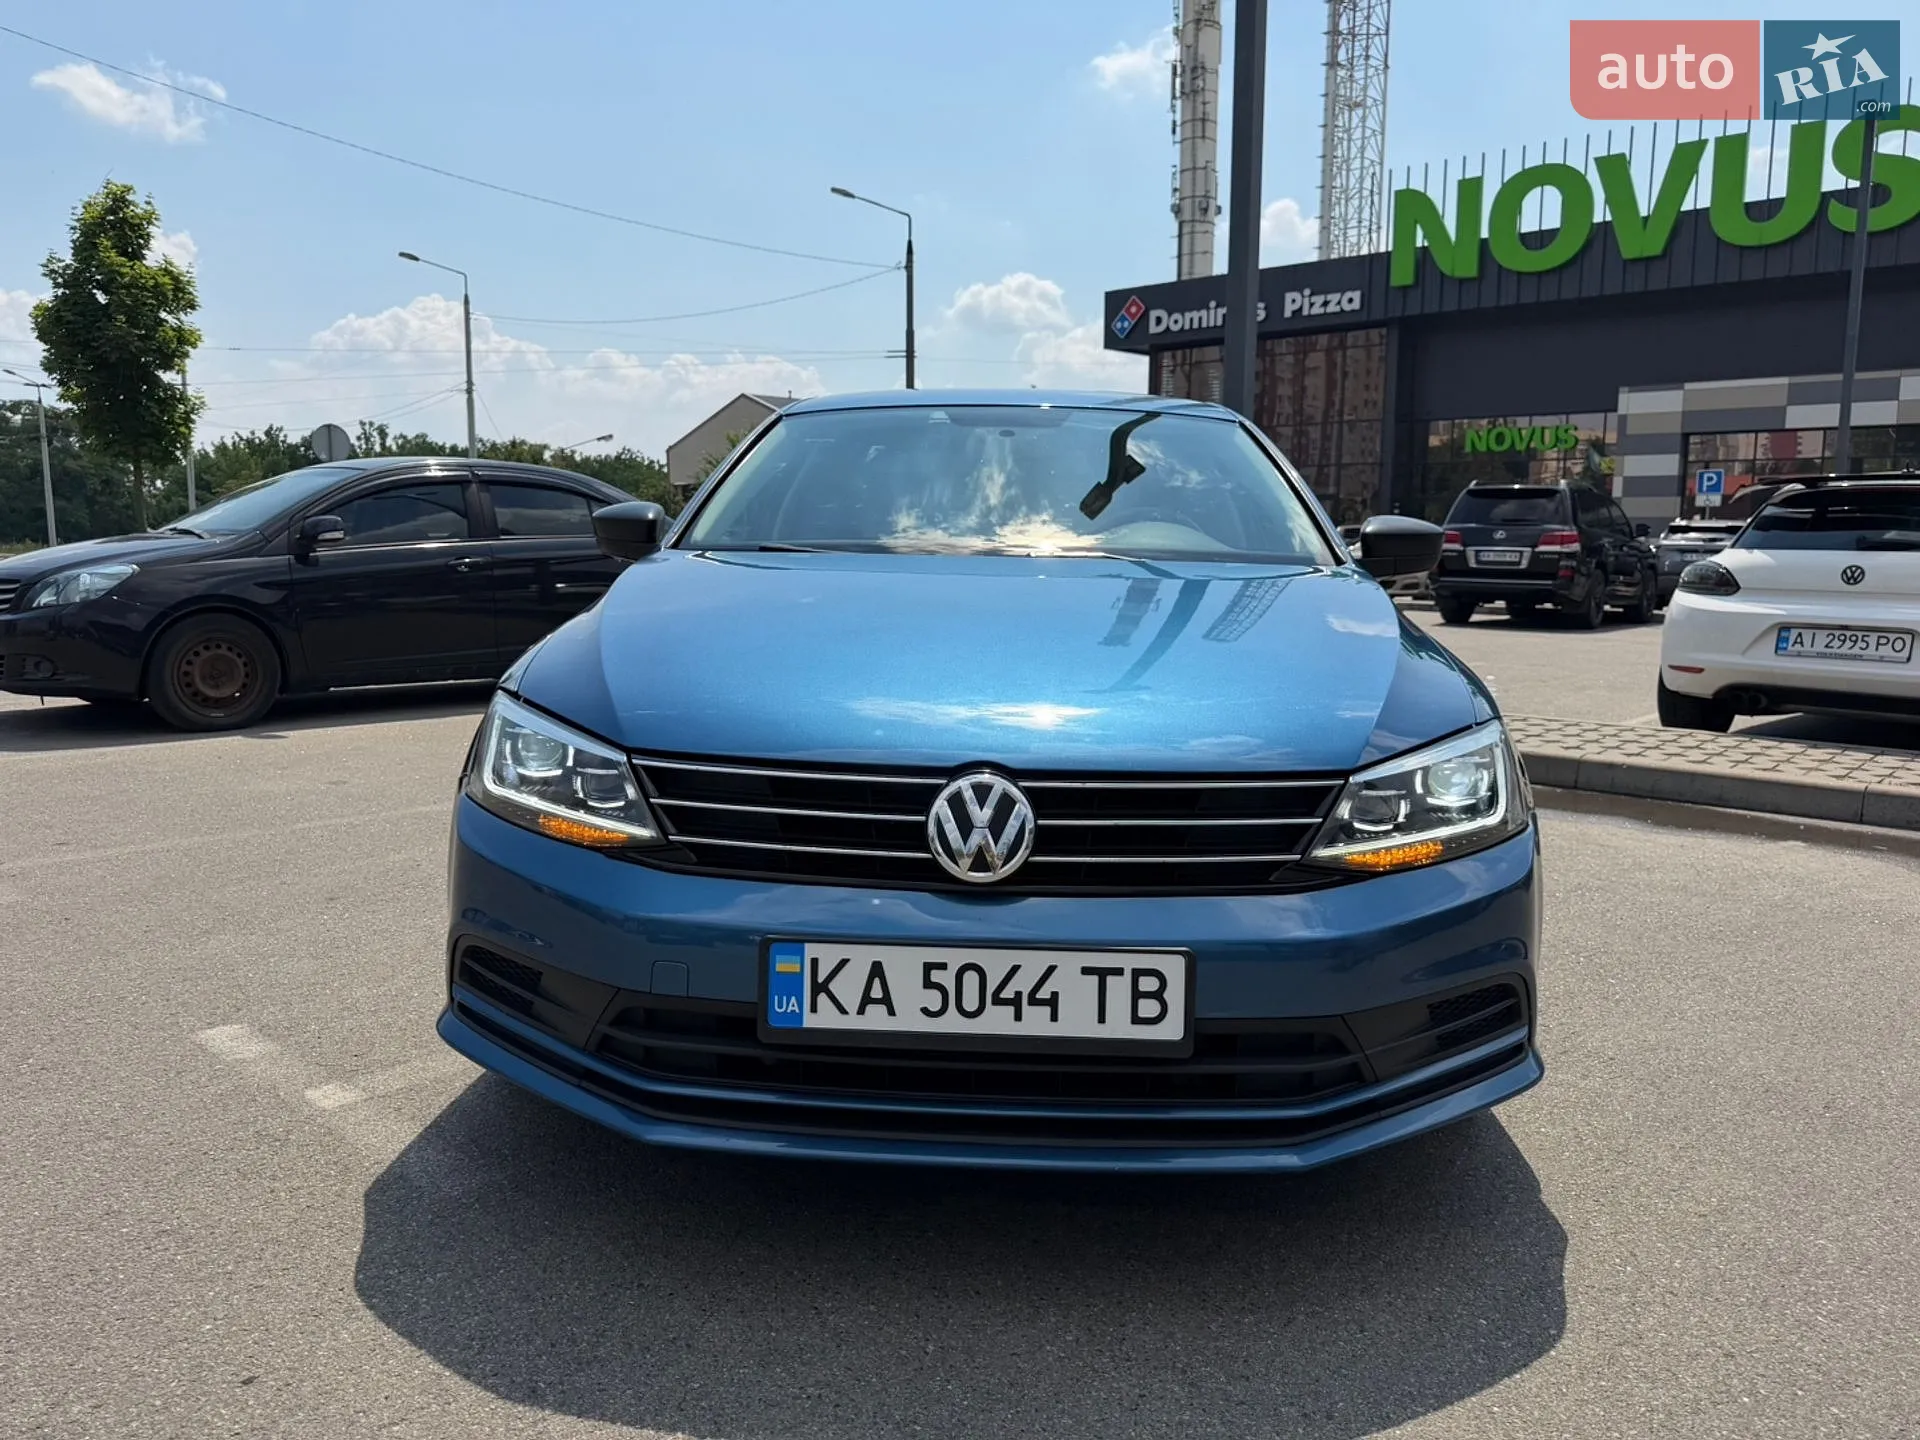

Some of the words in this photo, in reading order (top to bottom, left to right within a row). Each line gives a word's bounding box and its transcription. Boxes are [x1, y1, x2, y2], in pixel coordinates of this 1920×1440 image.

[1389, 104, 1920, 288] NOVUS
[1283, 288, 1362, 318] Pizza
[1464, 424, 1578, 454] NOVUS
[1702, 472, 1717, 492] P
[1824, 632, 1871, 651] 2995
[1875, 635, 1907, 654] PO
[774, 995, 800, 1013] UA
[809, 957, 897, 1017] KA
[920, 961, 1059, 1023] 5044
[1080, 965, 1169, 1026] TB
